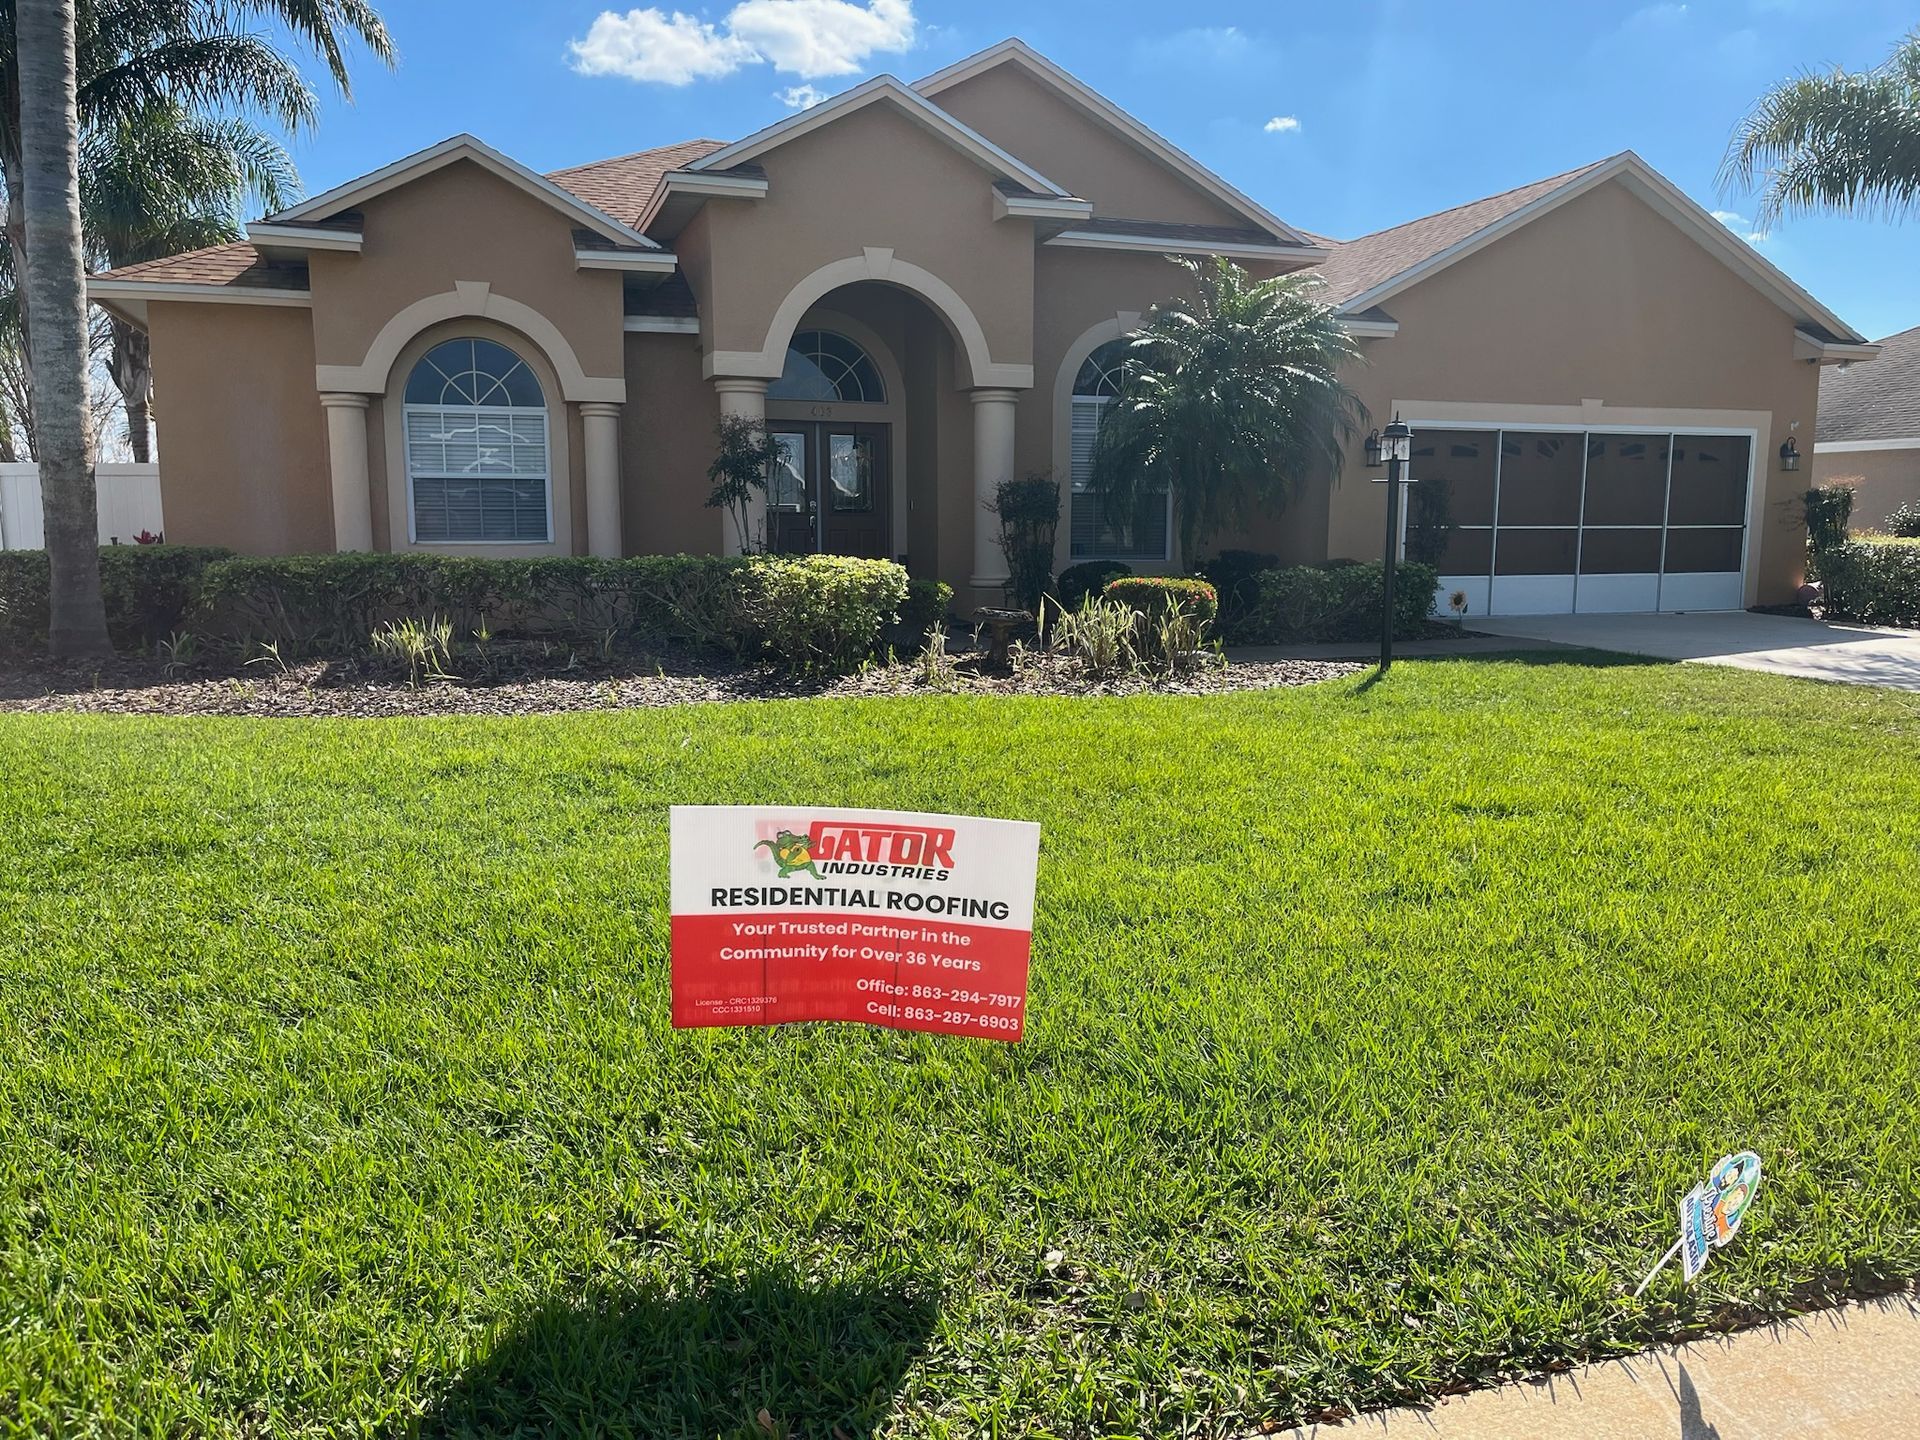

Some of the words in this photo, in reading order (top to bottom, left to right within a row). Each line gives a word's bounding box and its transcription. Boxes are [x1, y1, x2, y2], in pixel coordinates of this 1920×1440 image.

[809, 821, 956, 869] GATOR
[822, 862, 949, 882] INDUSTRIES
[711, 887, 880, 908] RESIDENTIAL
[887, 891, 1010, 920] ROOFING
[732, 922, 775, 936] Your
[779, 921, 848, 936] Trusted
[851, 923, 918, 941] Partner
[921, 928, 938, 943] in
[941, 931, 971, 946] the
[720, 944, 828, 962] Community
[831, 945, 857, 959] for
[860, 947, 903, 963] Over
[906, 950, 927, 965] 36
[930, 953, 982, 971] Years
[695, 999, 723, 1007] License
[856, 978, 909, 997] Office:
[912, 984, 1021, 1009] 863-294-7917
[866, 1001, 902, 1018] Cell:
[904, 1006, 1019, 1031] 863-287-6903
